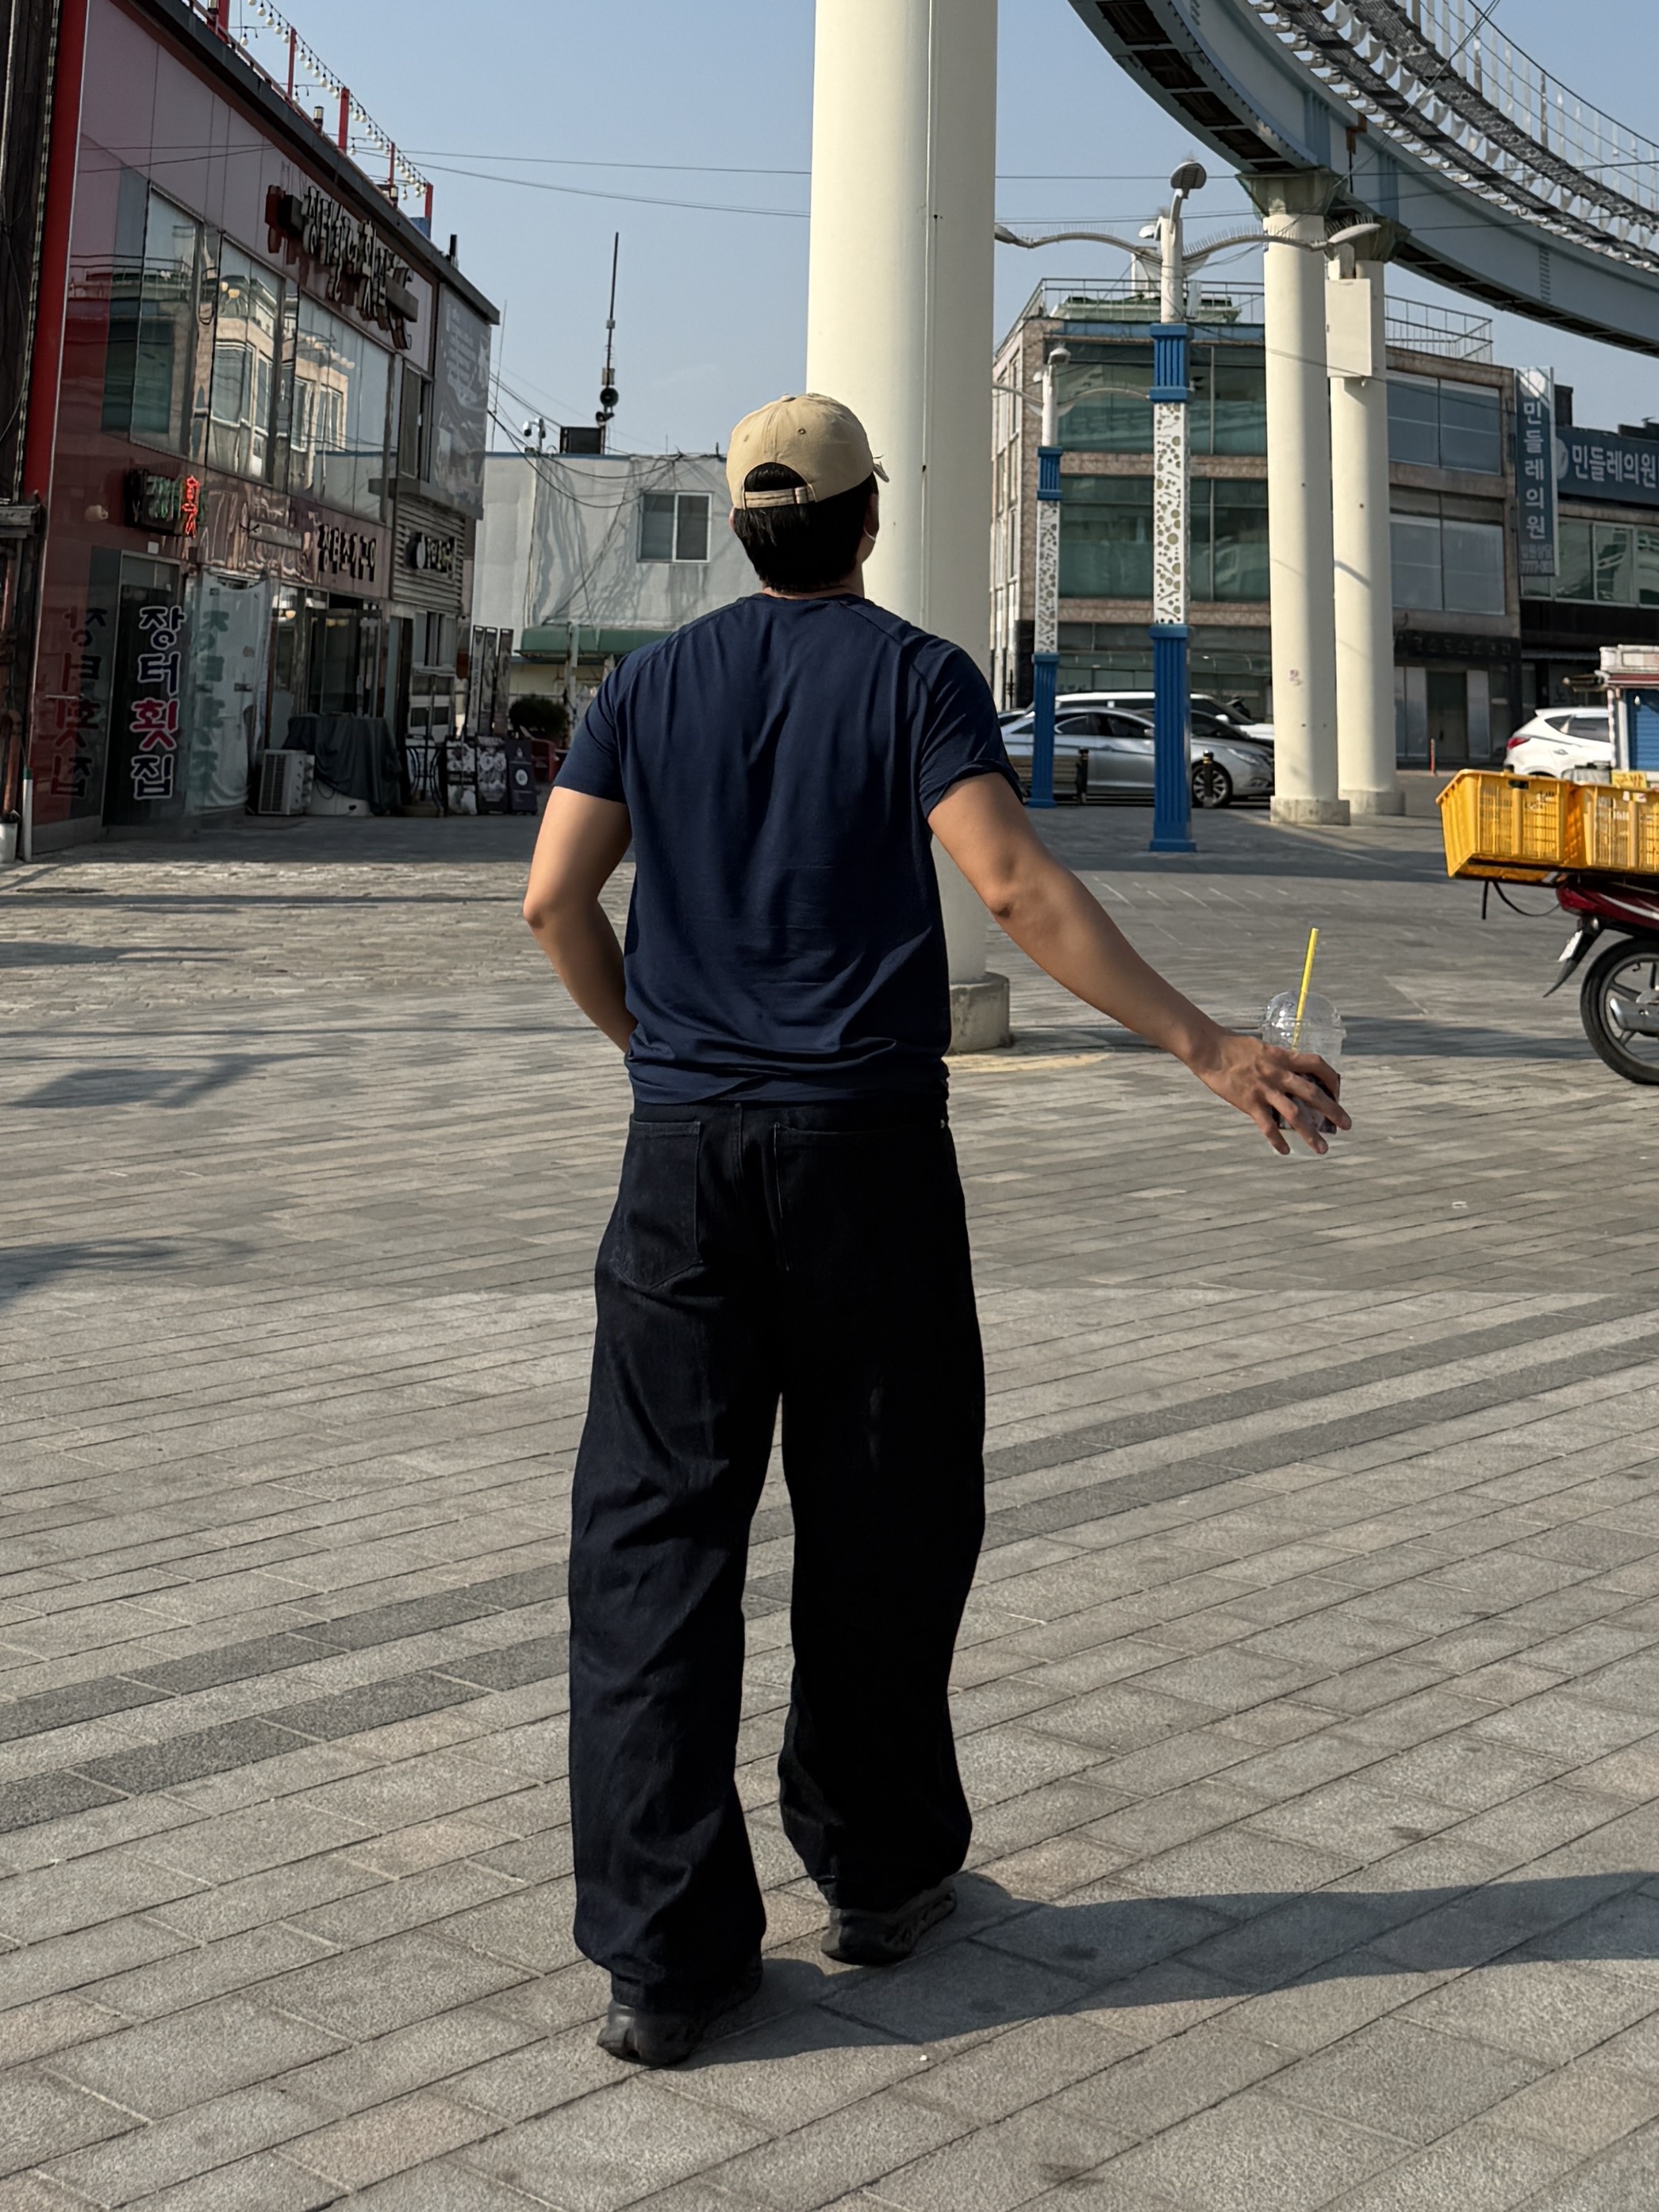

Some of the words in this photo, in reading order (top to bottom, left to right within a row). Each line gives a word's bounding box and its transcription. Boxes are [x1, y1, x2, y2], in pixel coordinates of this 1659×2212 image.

[1523, 401, 1546, 540] 민들레의원
[1572, 444, 1657, 489] 민들레의원
[129, 605, 186, 800] 장터횟집
